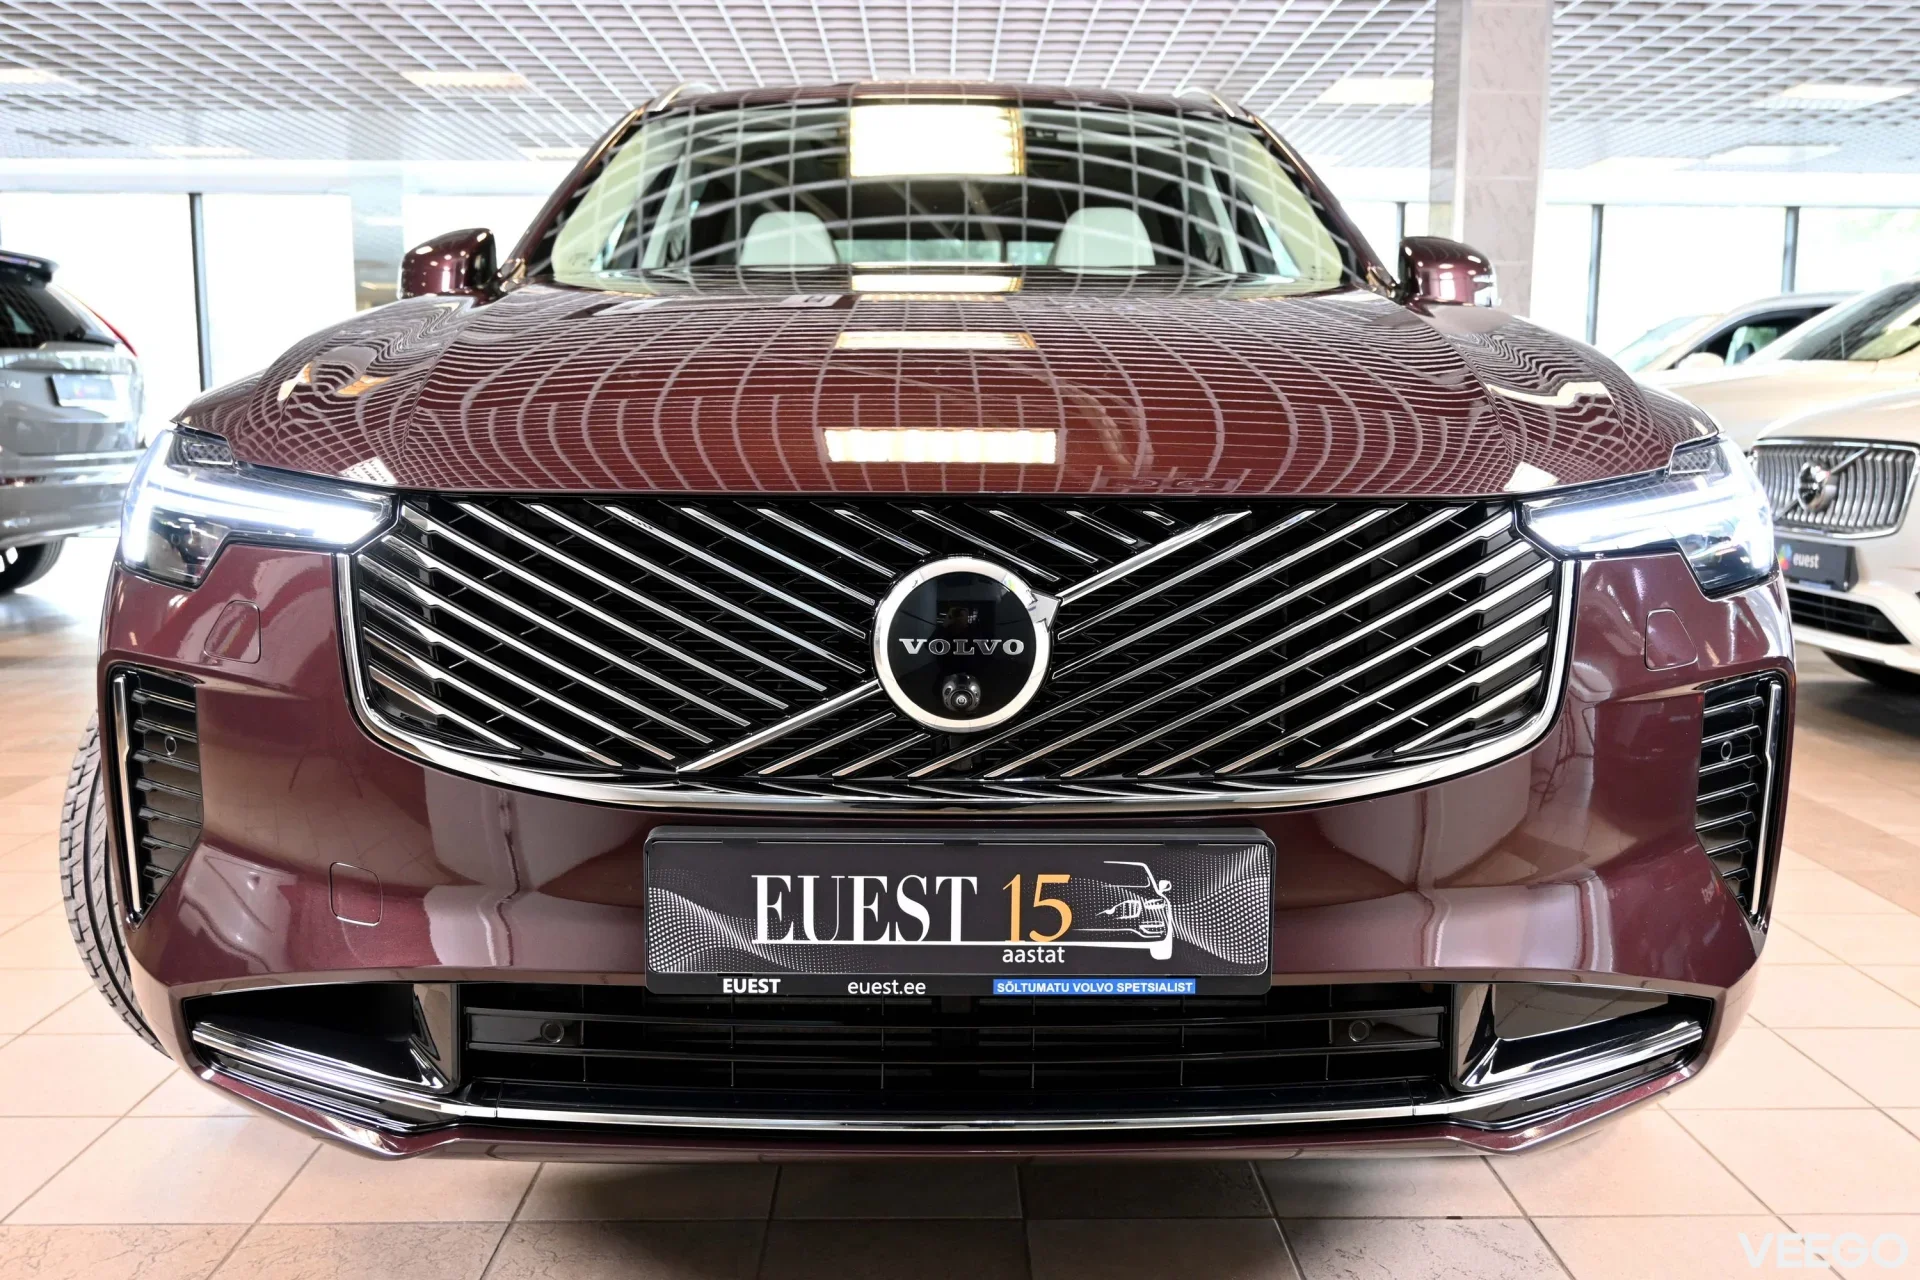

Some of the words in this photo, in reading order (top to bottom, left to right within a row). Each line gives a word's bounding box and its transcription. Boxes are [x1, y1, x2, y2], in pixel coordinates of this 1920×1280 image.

[1793, 553, 1820, 569] euest
[898, 638, 1025, 656] VOLVO
[751, 874, 978, 943] EUEST
[1002, 873, 1073, 943] 15
[1002, 946, 1065, 964] aastat
[722, 978, 781, 994] EUEST
[847, 979, 926, 995] euest.ee
[996, 981, 1070, 993] SÕLTUMATU
[1072, 982, 1114, 993] VOLVO
[1116, 982, 1193, 993] SPETSIALIST
